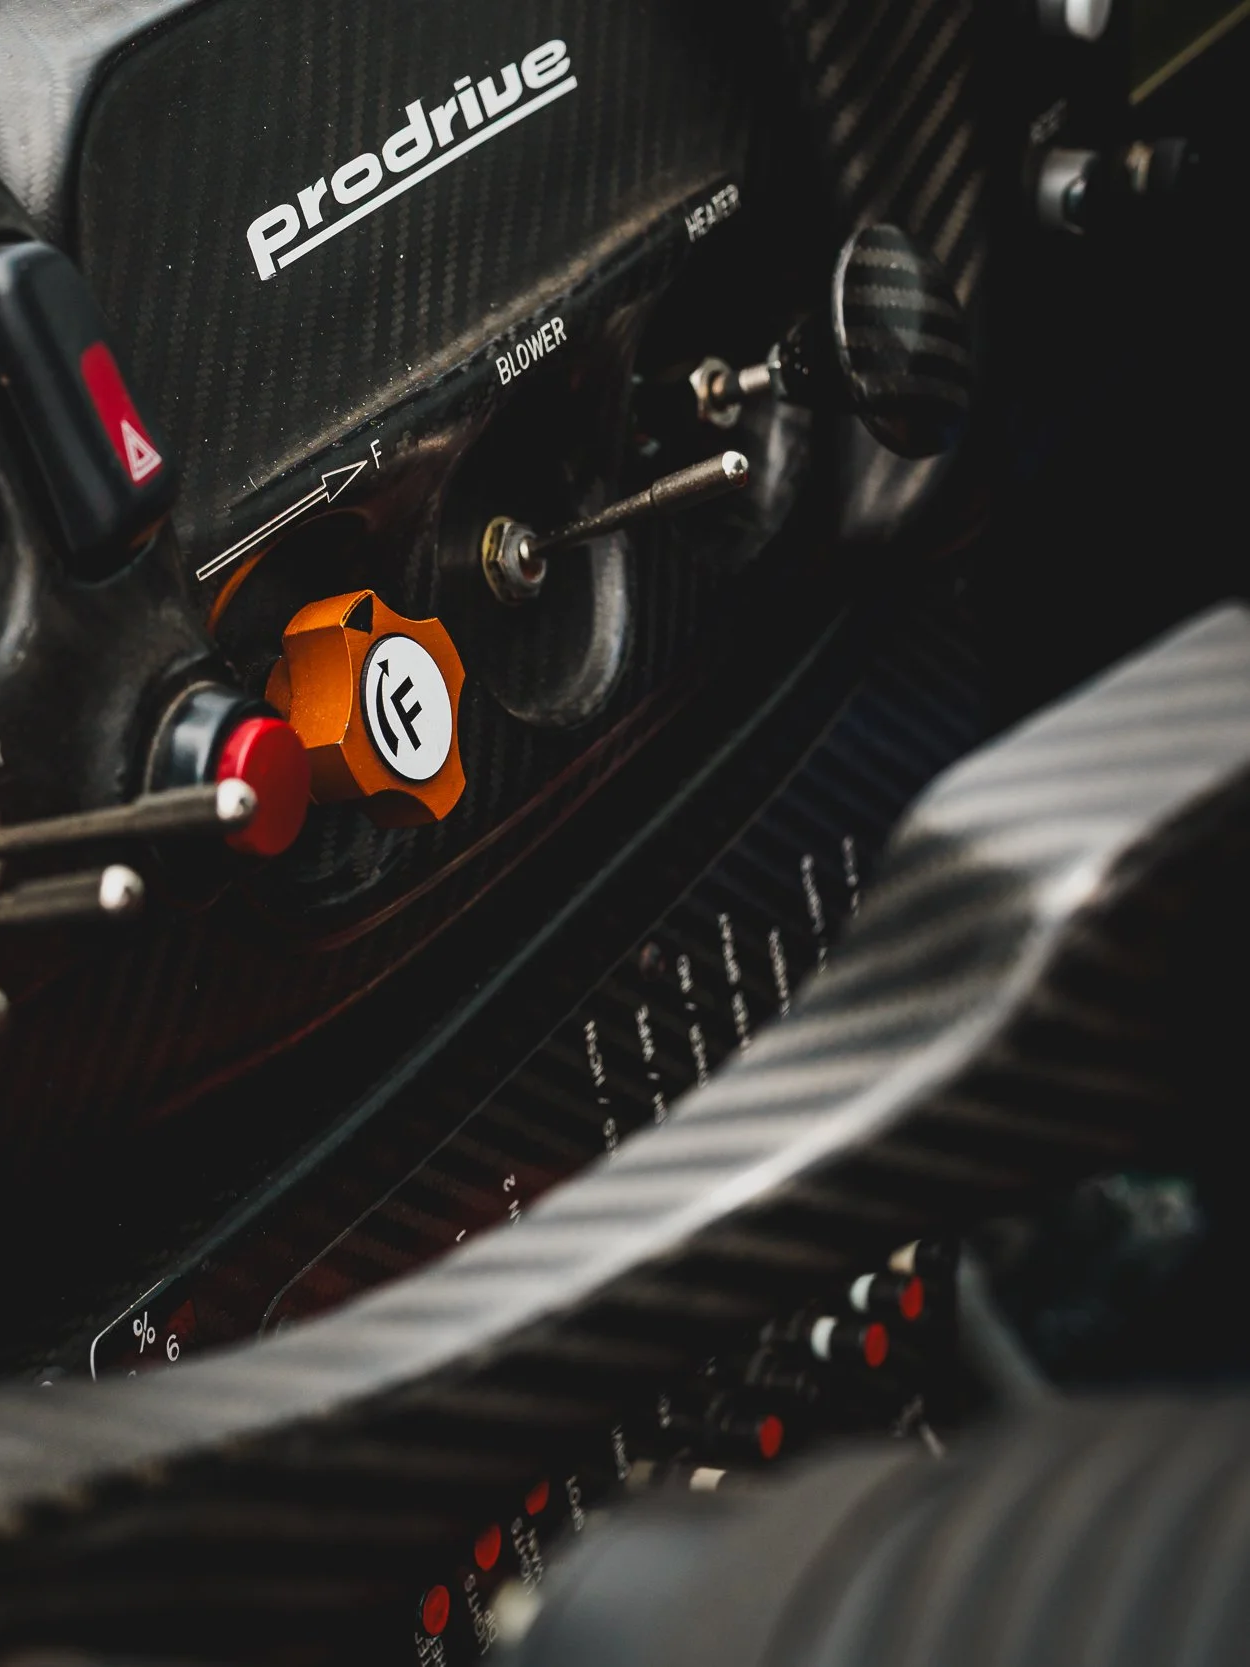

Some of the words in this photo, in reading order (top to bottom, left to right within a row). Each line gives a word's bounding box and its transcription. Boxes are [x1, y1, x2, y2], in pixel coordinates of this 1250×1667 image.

[247, 38, 573, 281] prodrive
[683, 183, 742, 243] HEATER
[495, 315, 568, 387] BLOWER
[369, 439, 384, 470] F
[390, 675, 423, 751] F
[166, 1334, 180, 1362] 6
[463, 1572, 490, 1656] LIGHTS
